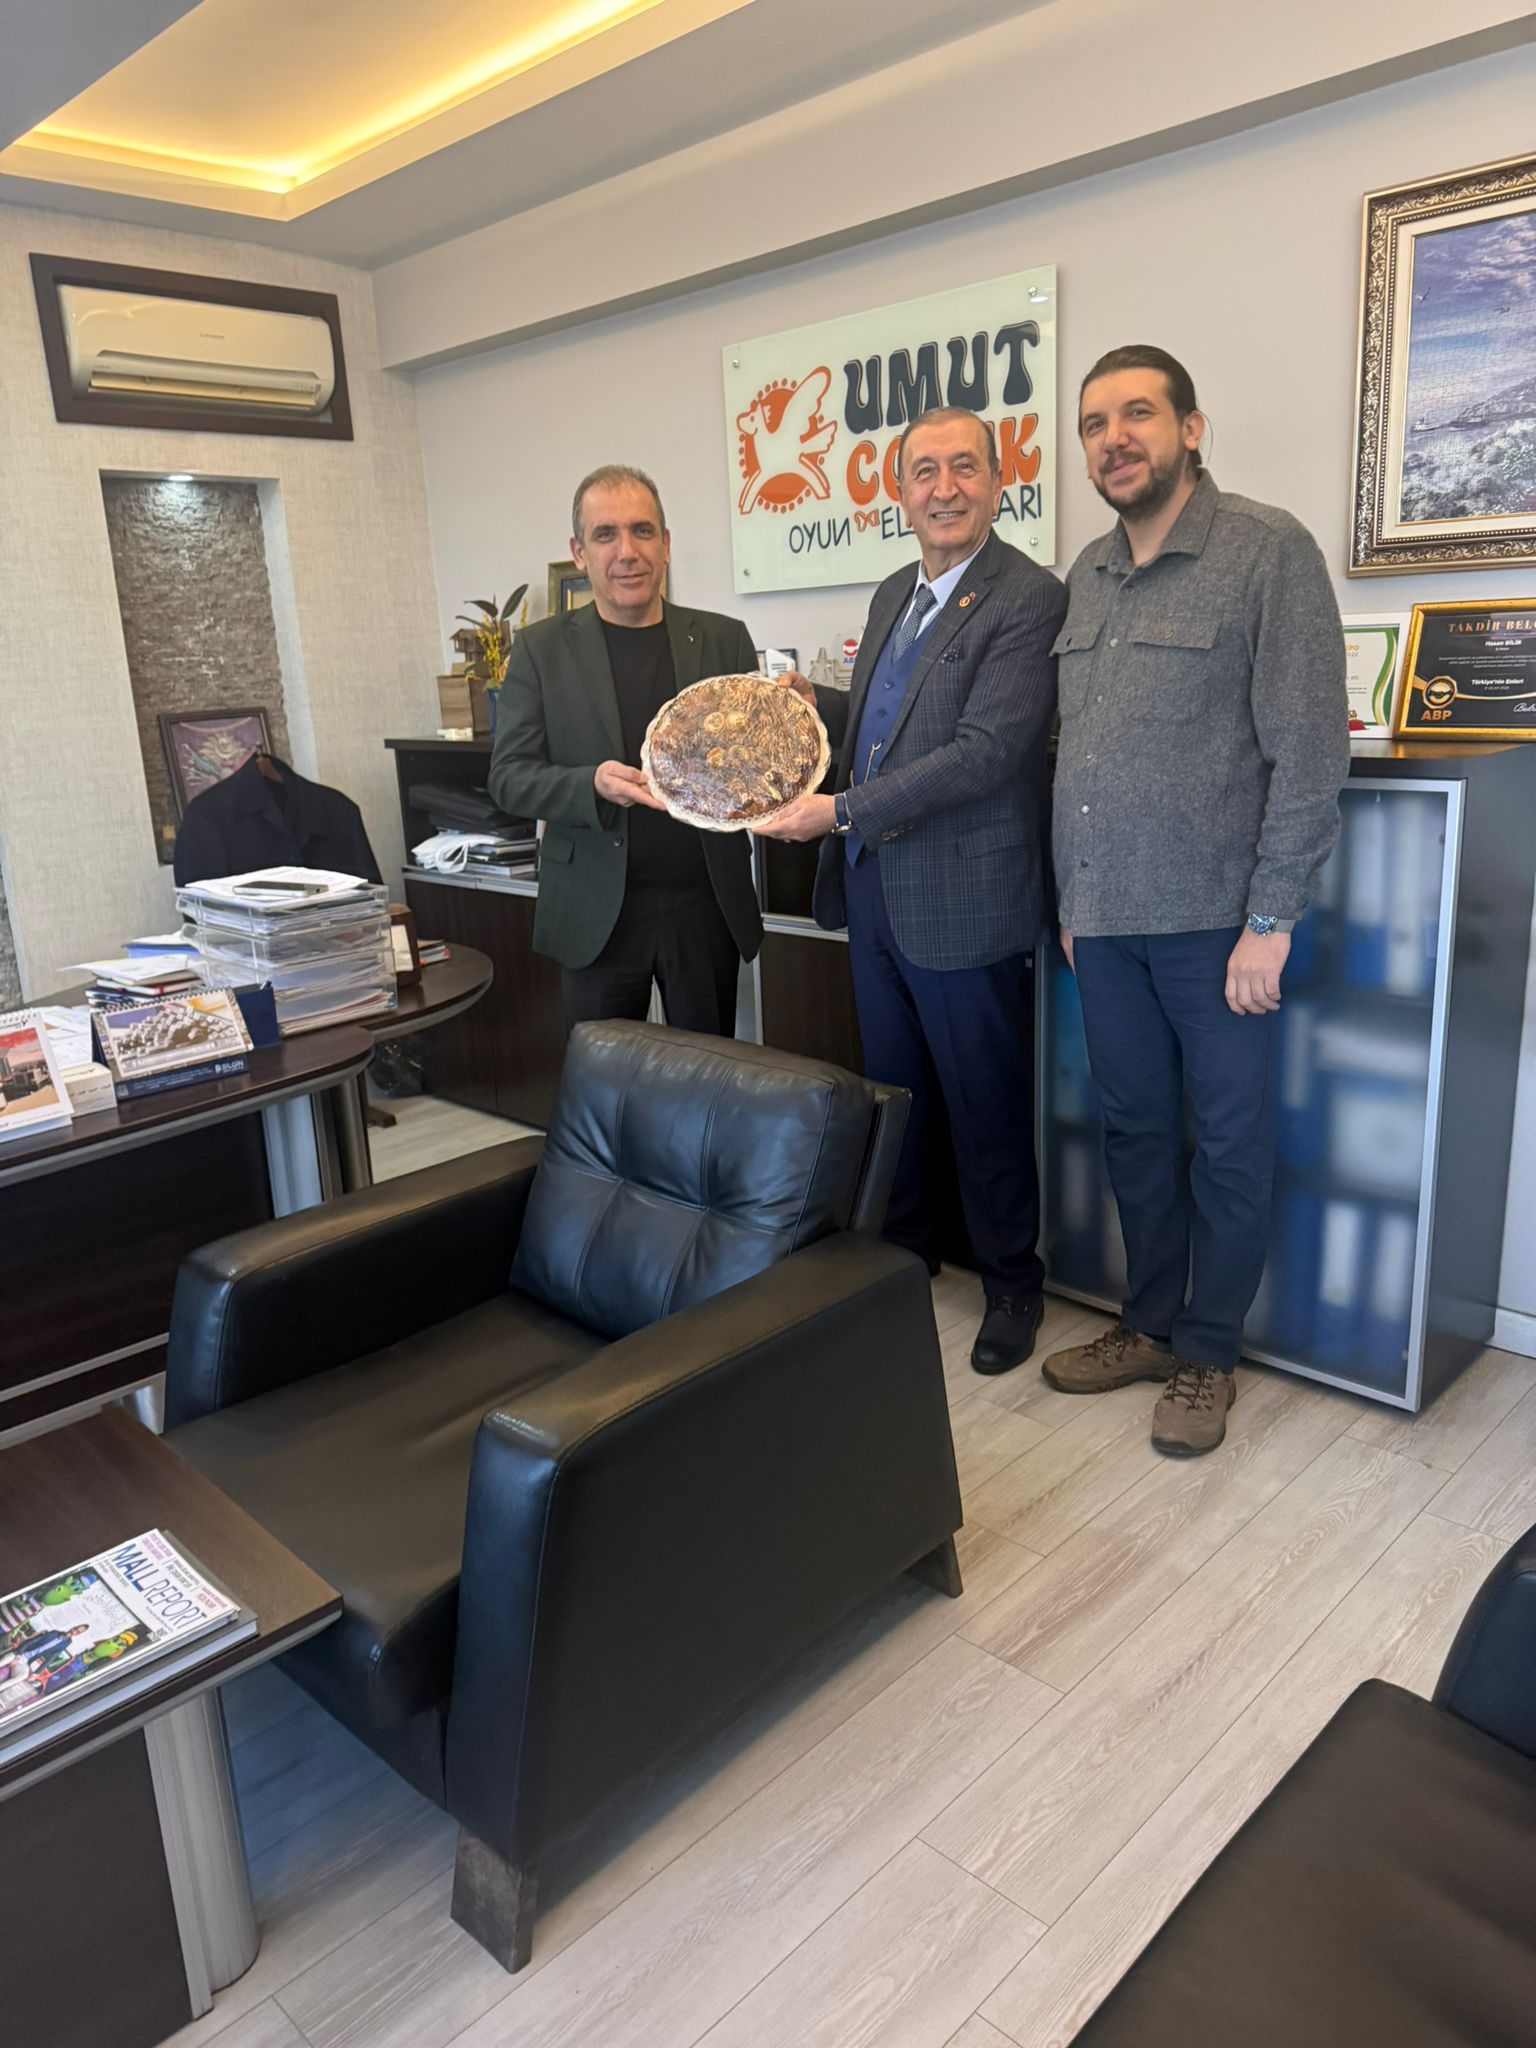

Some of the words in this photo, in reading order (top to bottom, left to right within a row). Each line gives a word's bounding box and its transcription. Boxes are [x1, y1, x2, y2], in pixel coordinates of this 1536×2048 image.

[843, 320, 1040, 435] UMUT
[789, 522, 852, 554] OYUN
[1421, 709, 1452, 720] ABP
